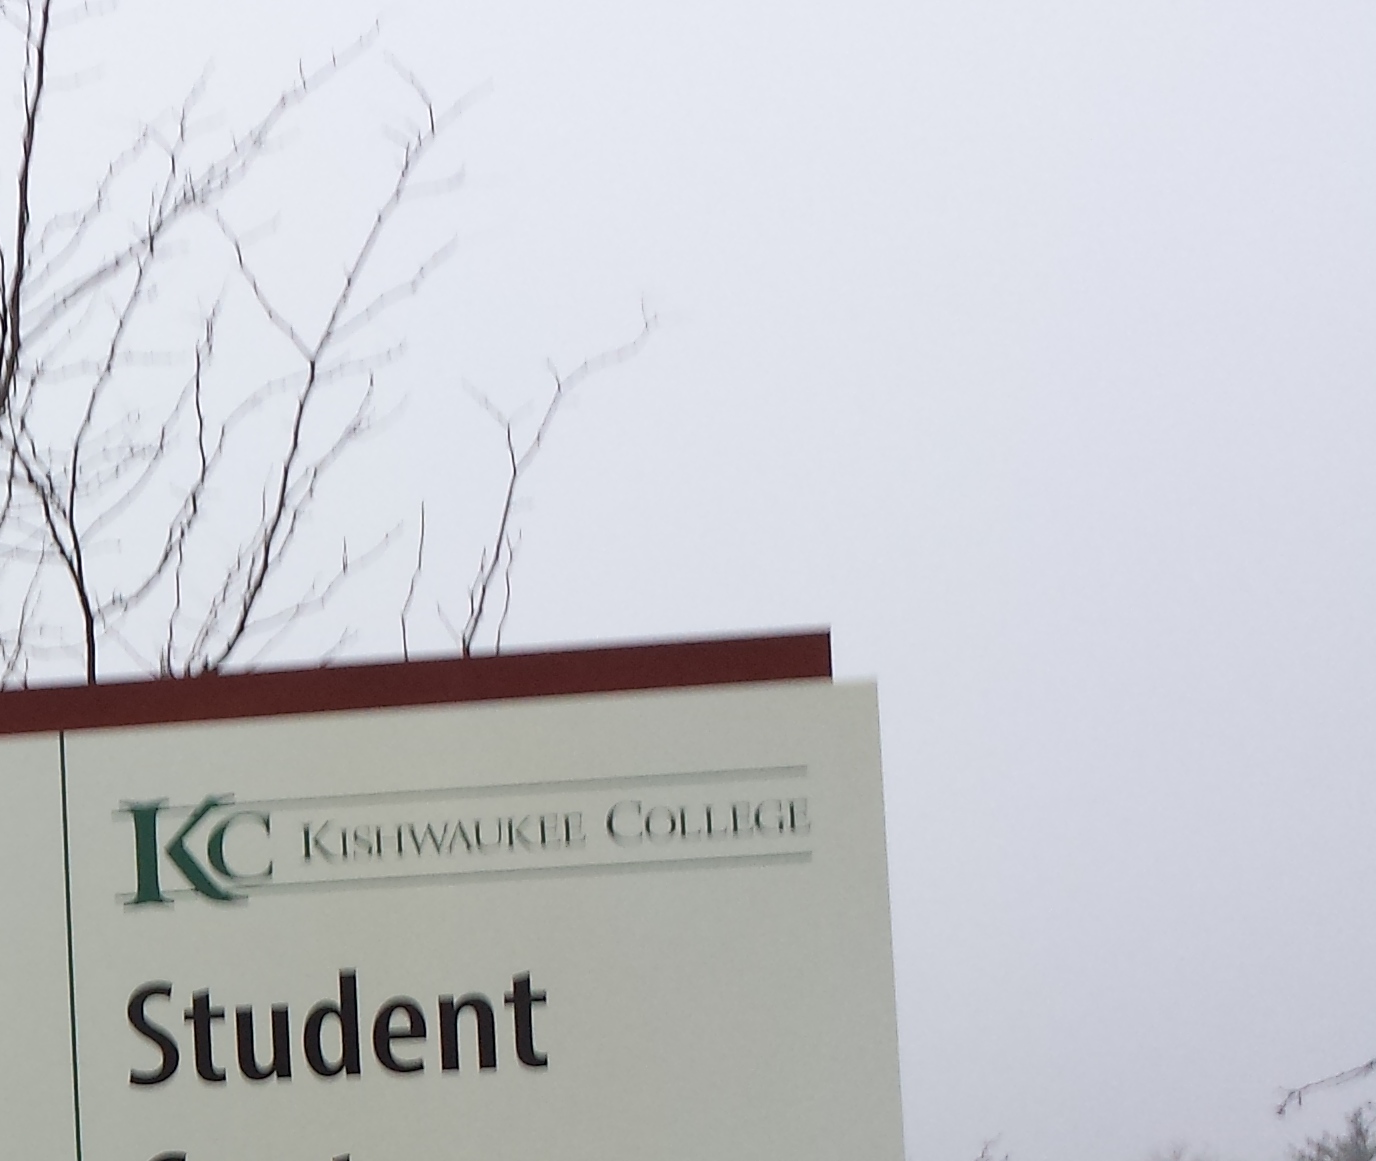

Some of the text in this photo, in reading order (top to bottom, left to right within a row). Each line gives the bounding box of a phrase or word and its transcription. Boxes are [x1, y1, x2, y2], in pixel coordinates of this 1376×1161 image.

[118, 793, 274, 911] KC
[301, 797, 812, 864] KISHWAUKEE COLLEGE
[126, 967, 548, 1086] Student
